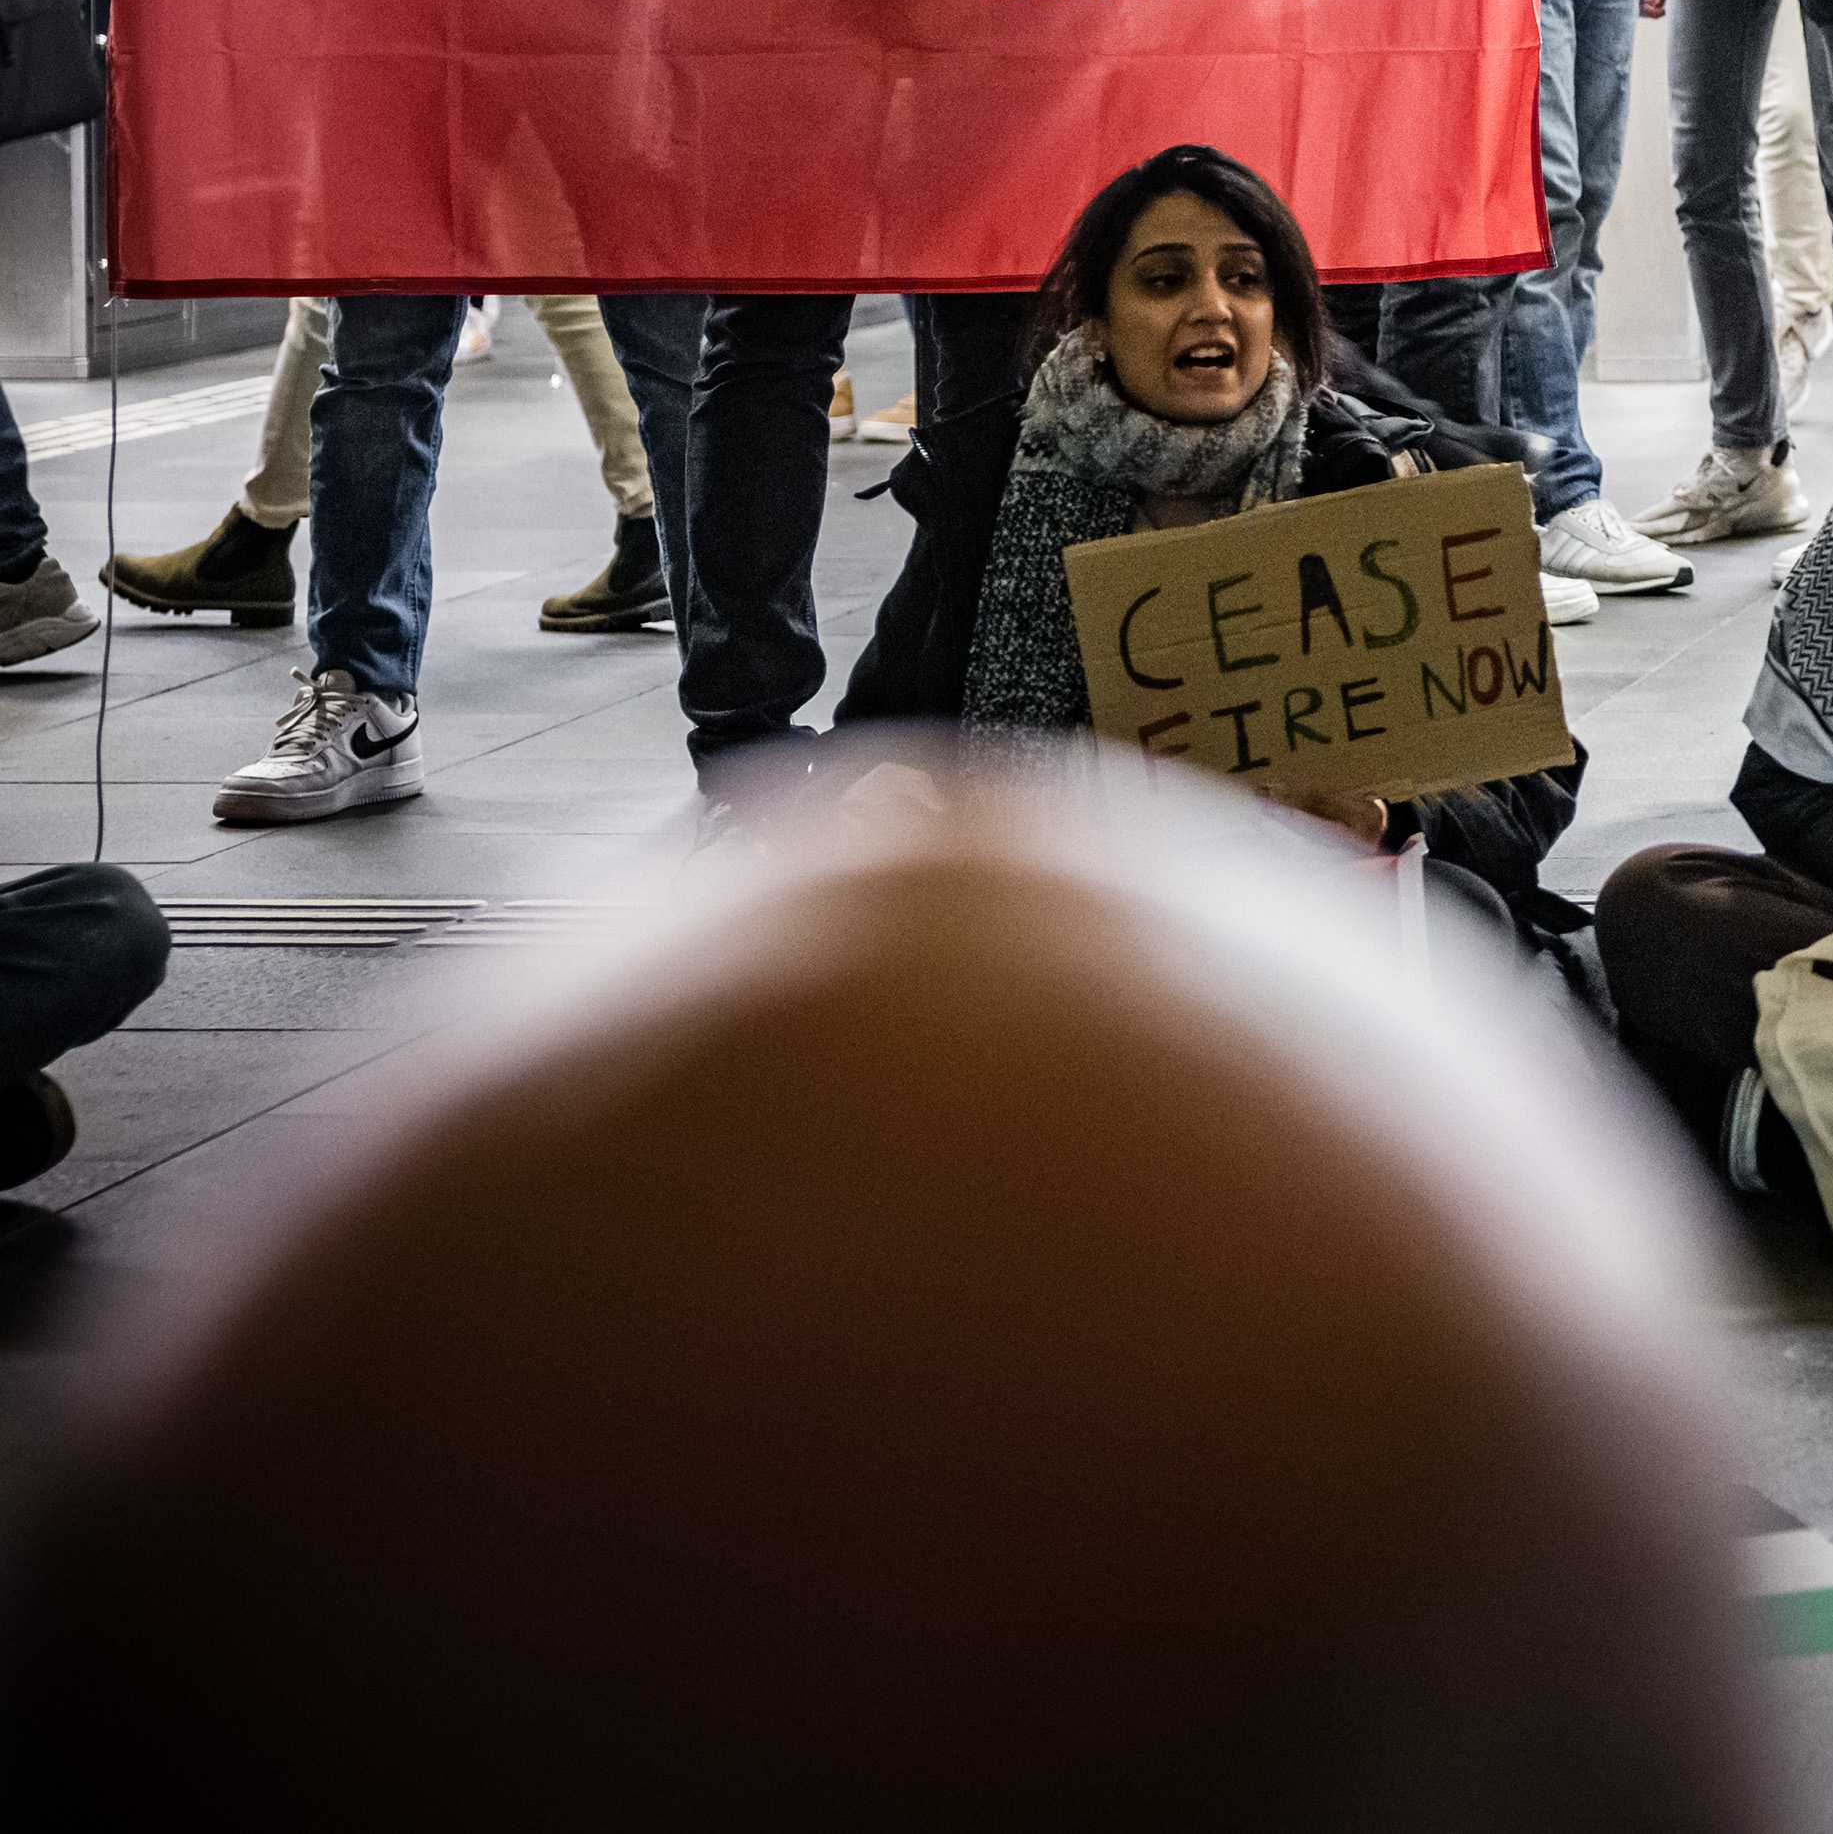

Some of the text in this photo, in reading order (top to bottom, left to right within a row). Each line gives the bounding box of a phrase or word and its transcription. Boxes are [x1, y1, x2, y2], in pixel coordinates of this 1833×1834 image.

[1118, 528, 1506, 691] CEASE
[1137, 619, 1550, 778] FIRE NOW
